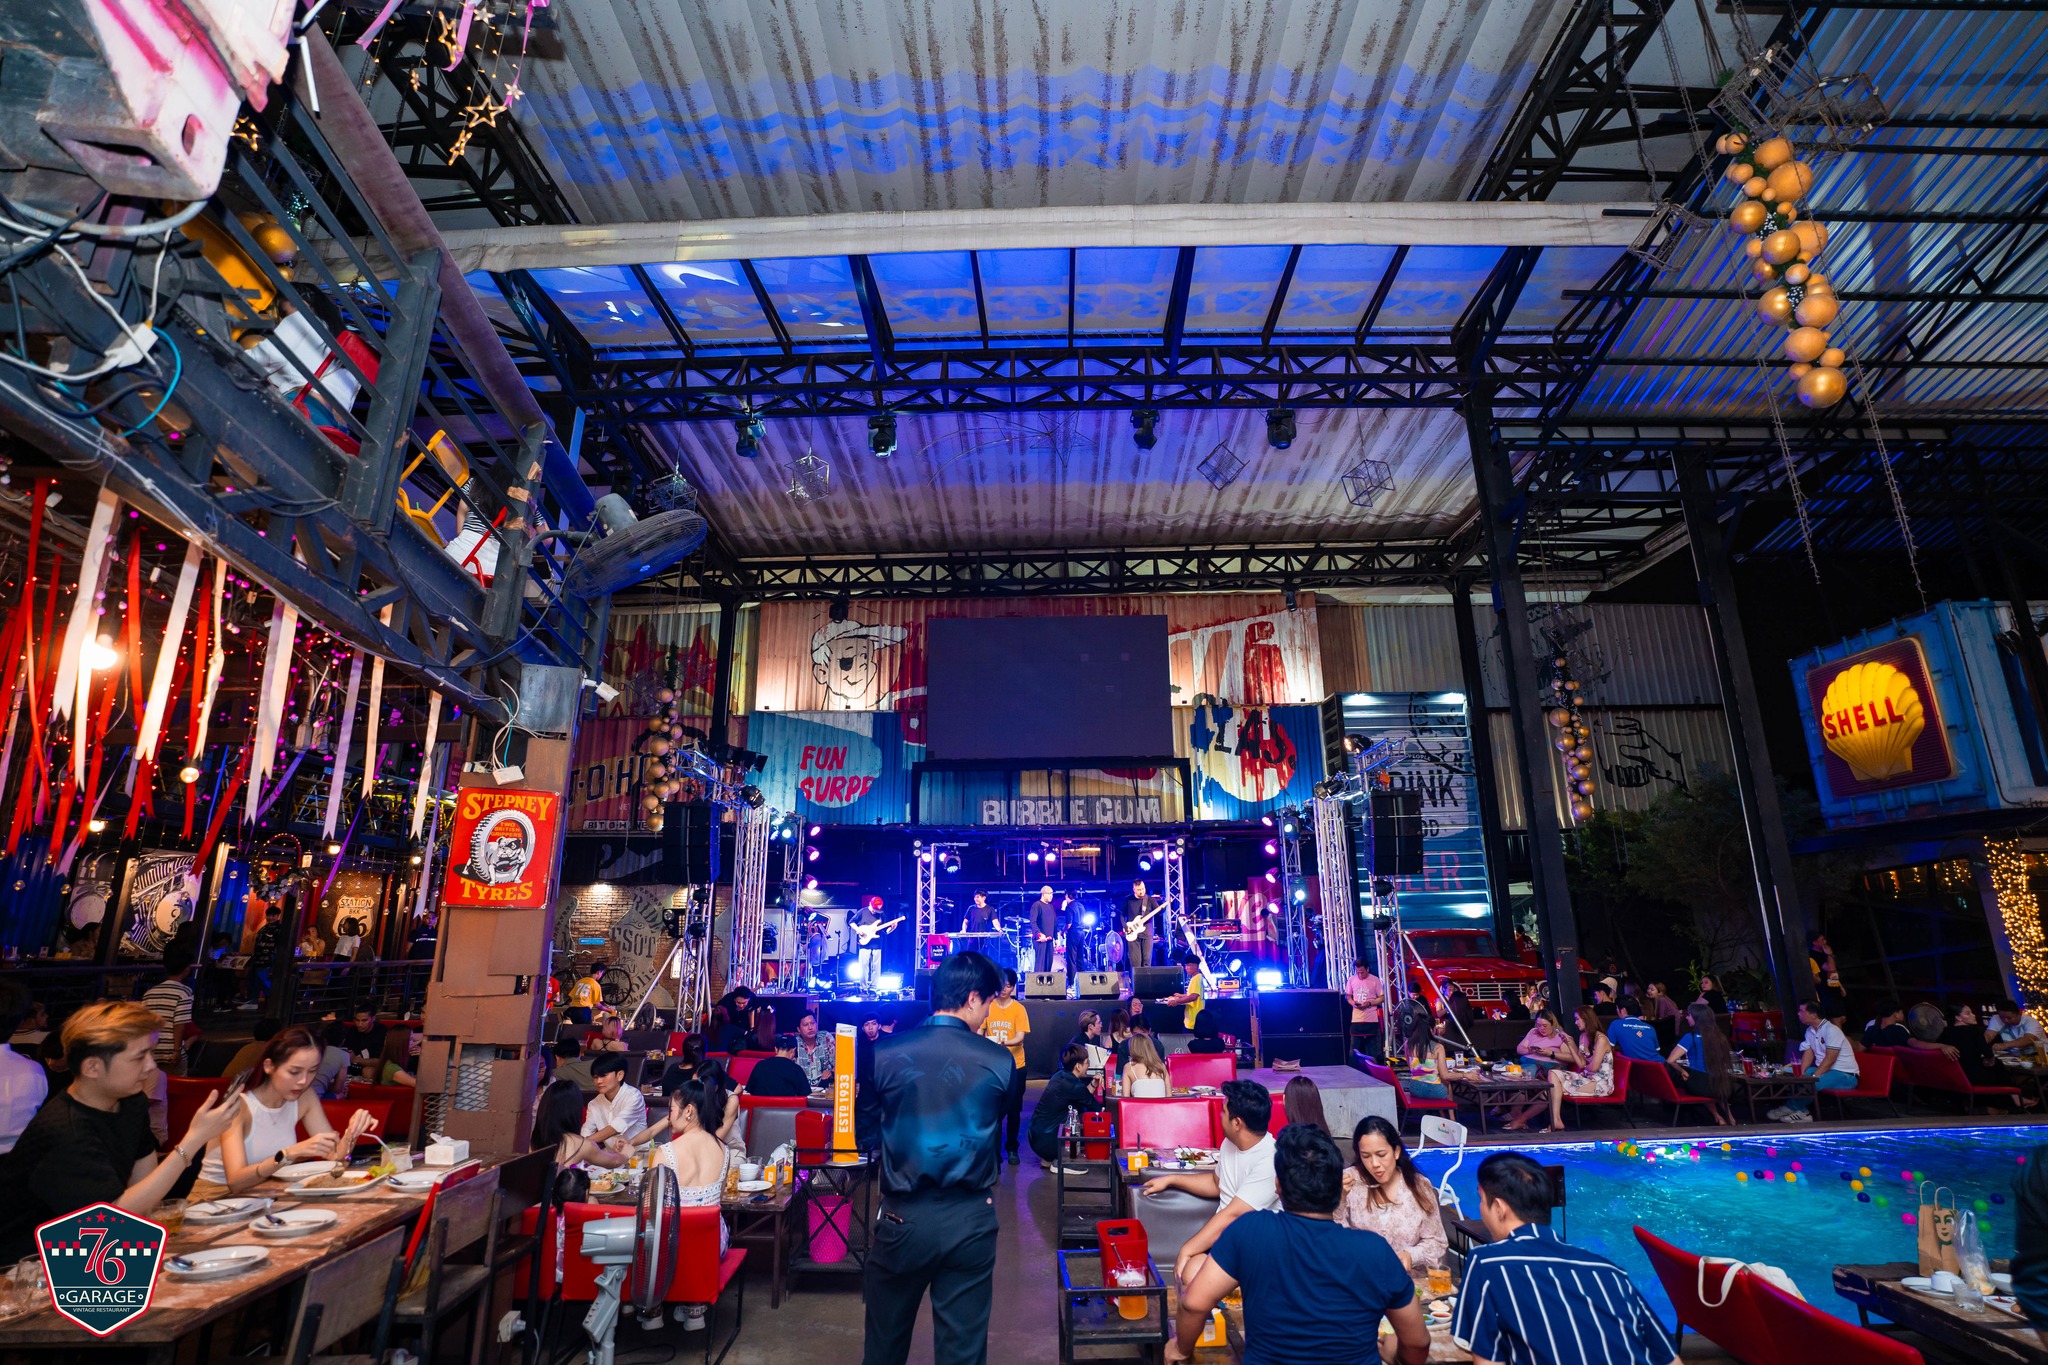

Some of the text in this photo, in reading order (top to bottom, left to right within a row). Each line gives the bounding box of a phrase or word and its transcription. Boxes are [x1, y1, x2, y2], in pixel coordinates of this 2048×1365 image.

[1824, 696, 1905, 740] SHELL
[800, 745, 848, 771] FUN
[462, 792, 553, 821] STEPNEY
[982, 799, 1088, 826] BUBBLE
[460, 877, 533, 901] TYRES
[340, 898, 372, 908] STATION
[575, 982, 592, 998] 76
[990, 1020, 1012, 1030] GARAGE
[838, 1074, 850, 1133] ESTD 1933
